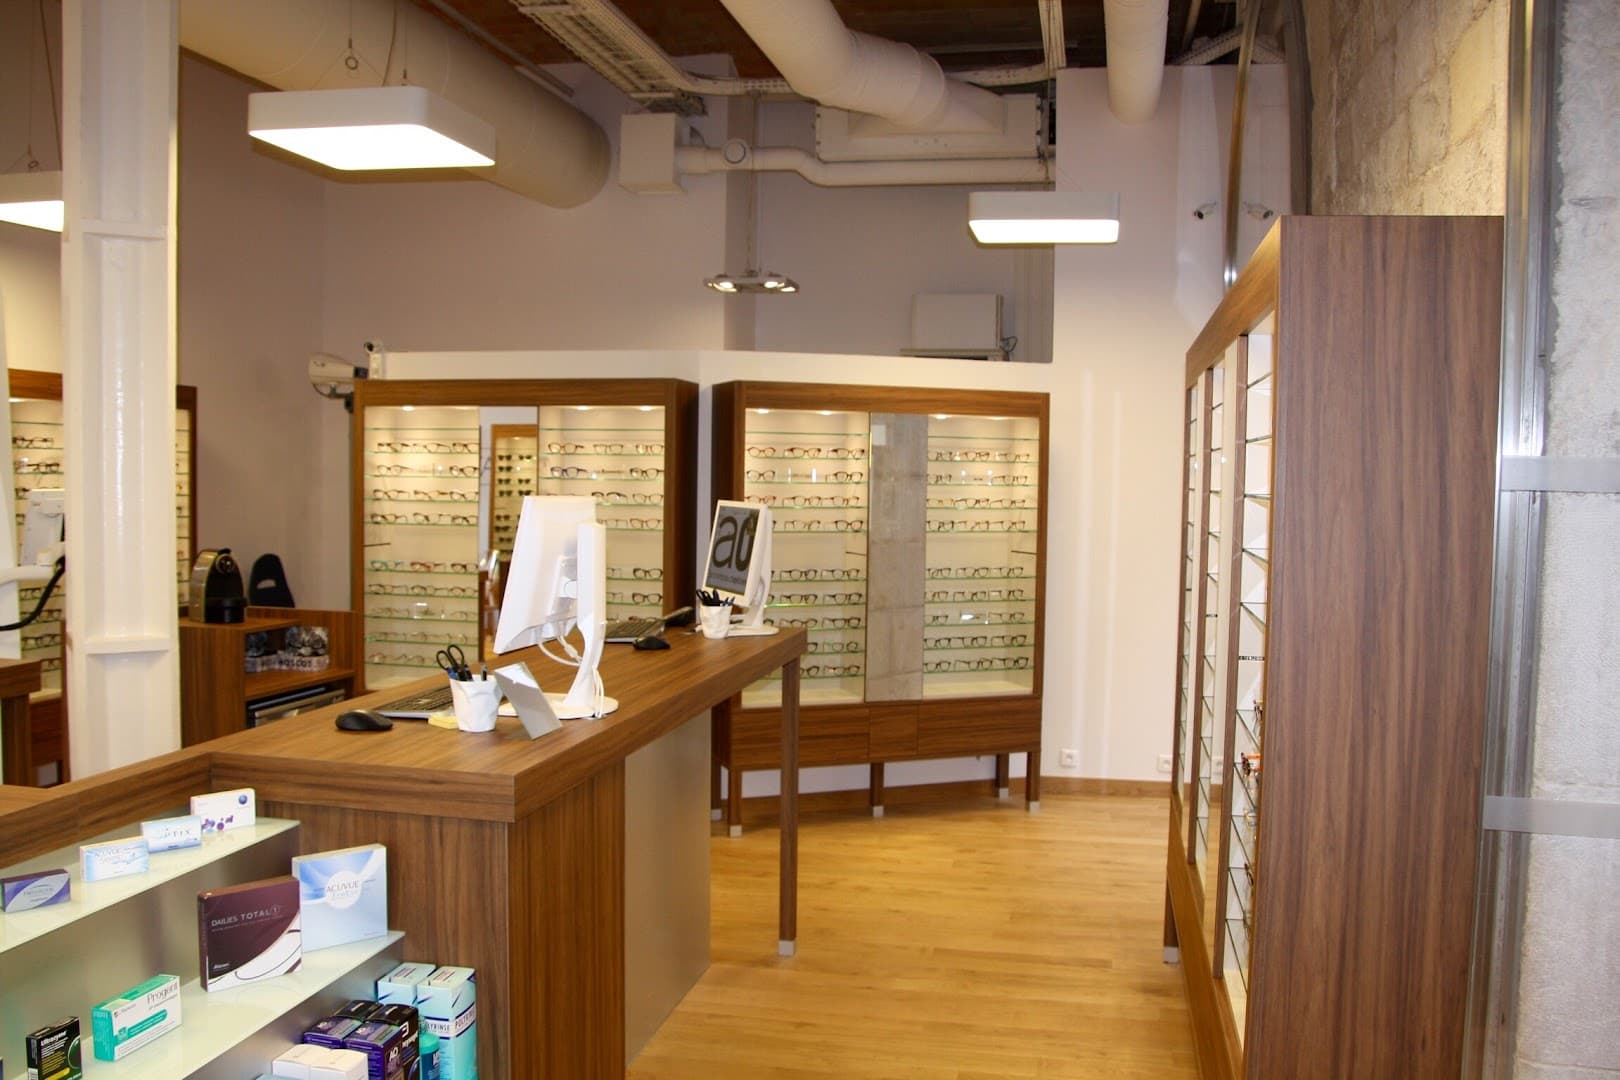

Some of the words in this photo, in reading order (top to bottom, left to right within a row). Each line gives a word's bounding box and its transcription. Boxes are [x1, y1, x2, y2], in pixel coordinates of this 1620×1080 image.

[327, 880, 360, 893] ACUVUE
[211, 916, 239, 927] DAILIES
[240, 909, 271, 920] TOTAL
